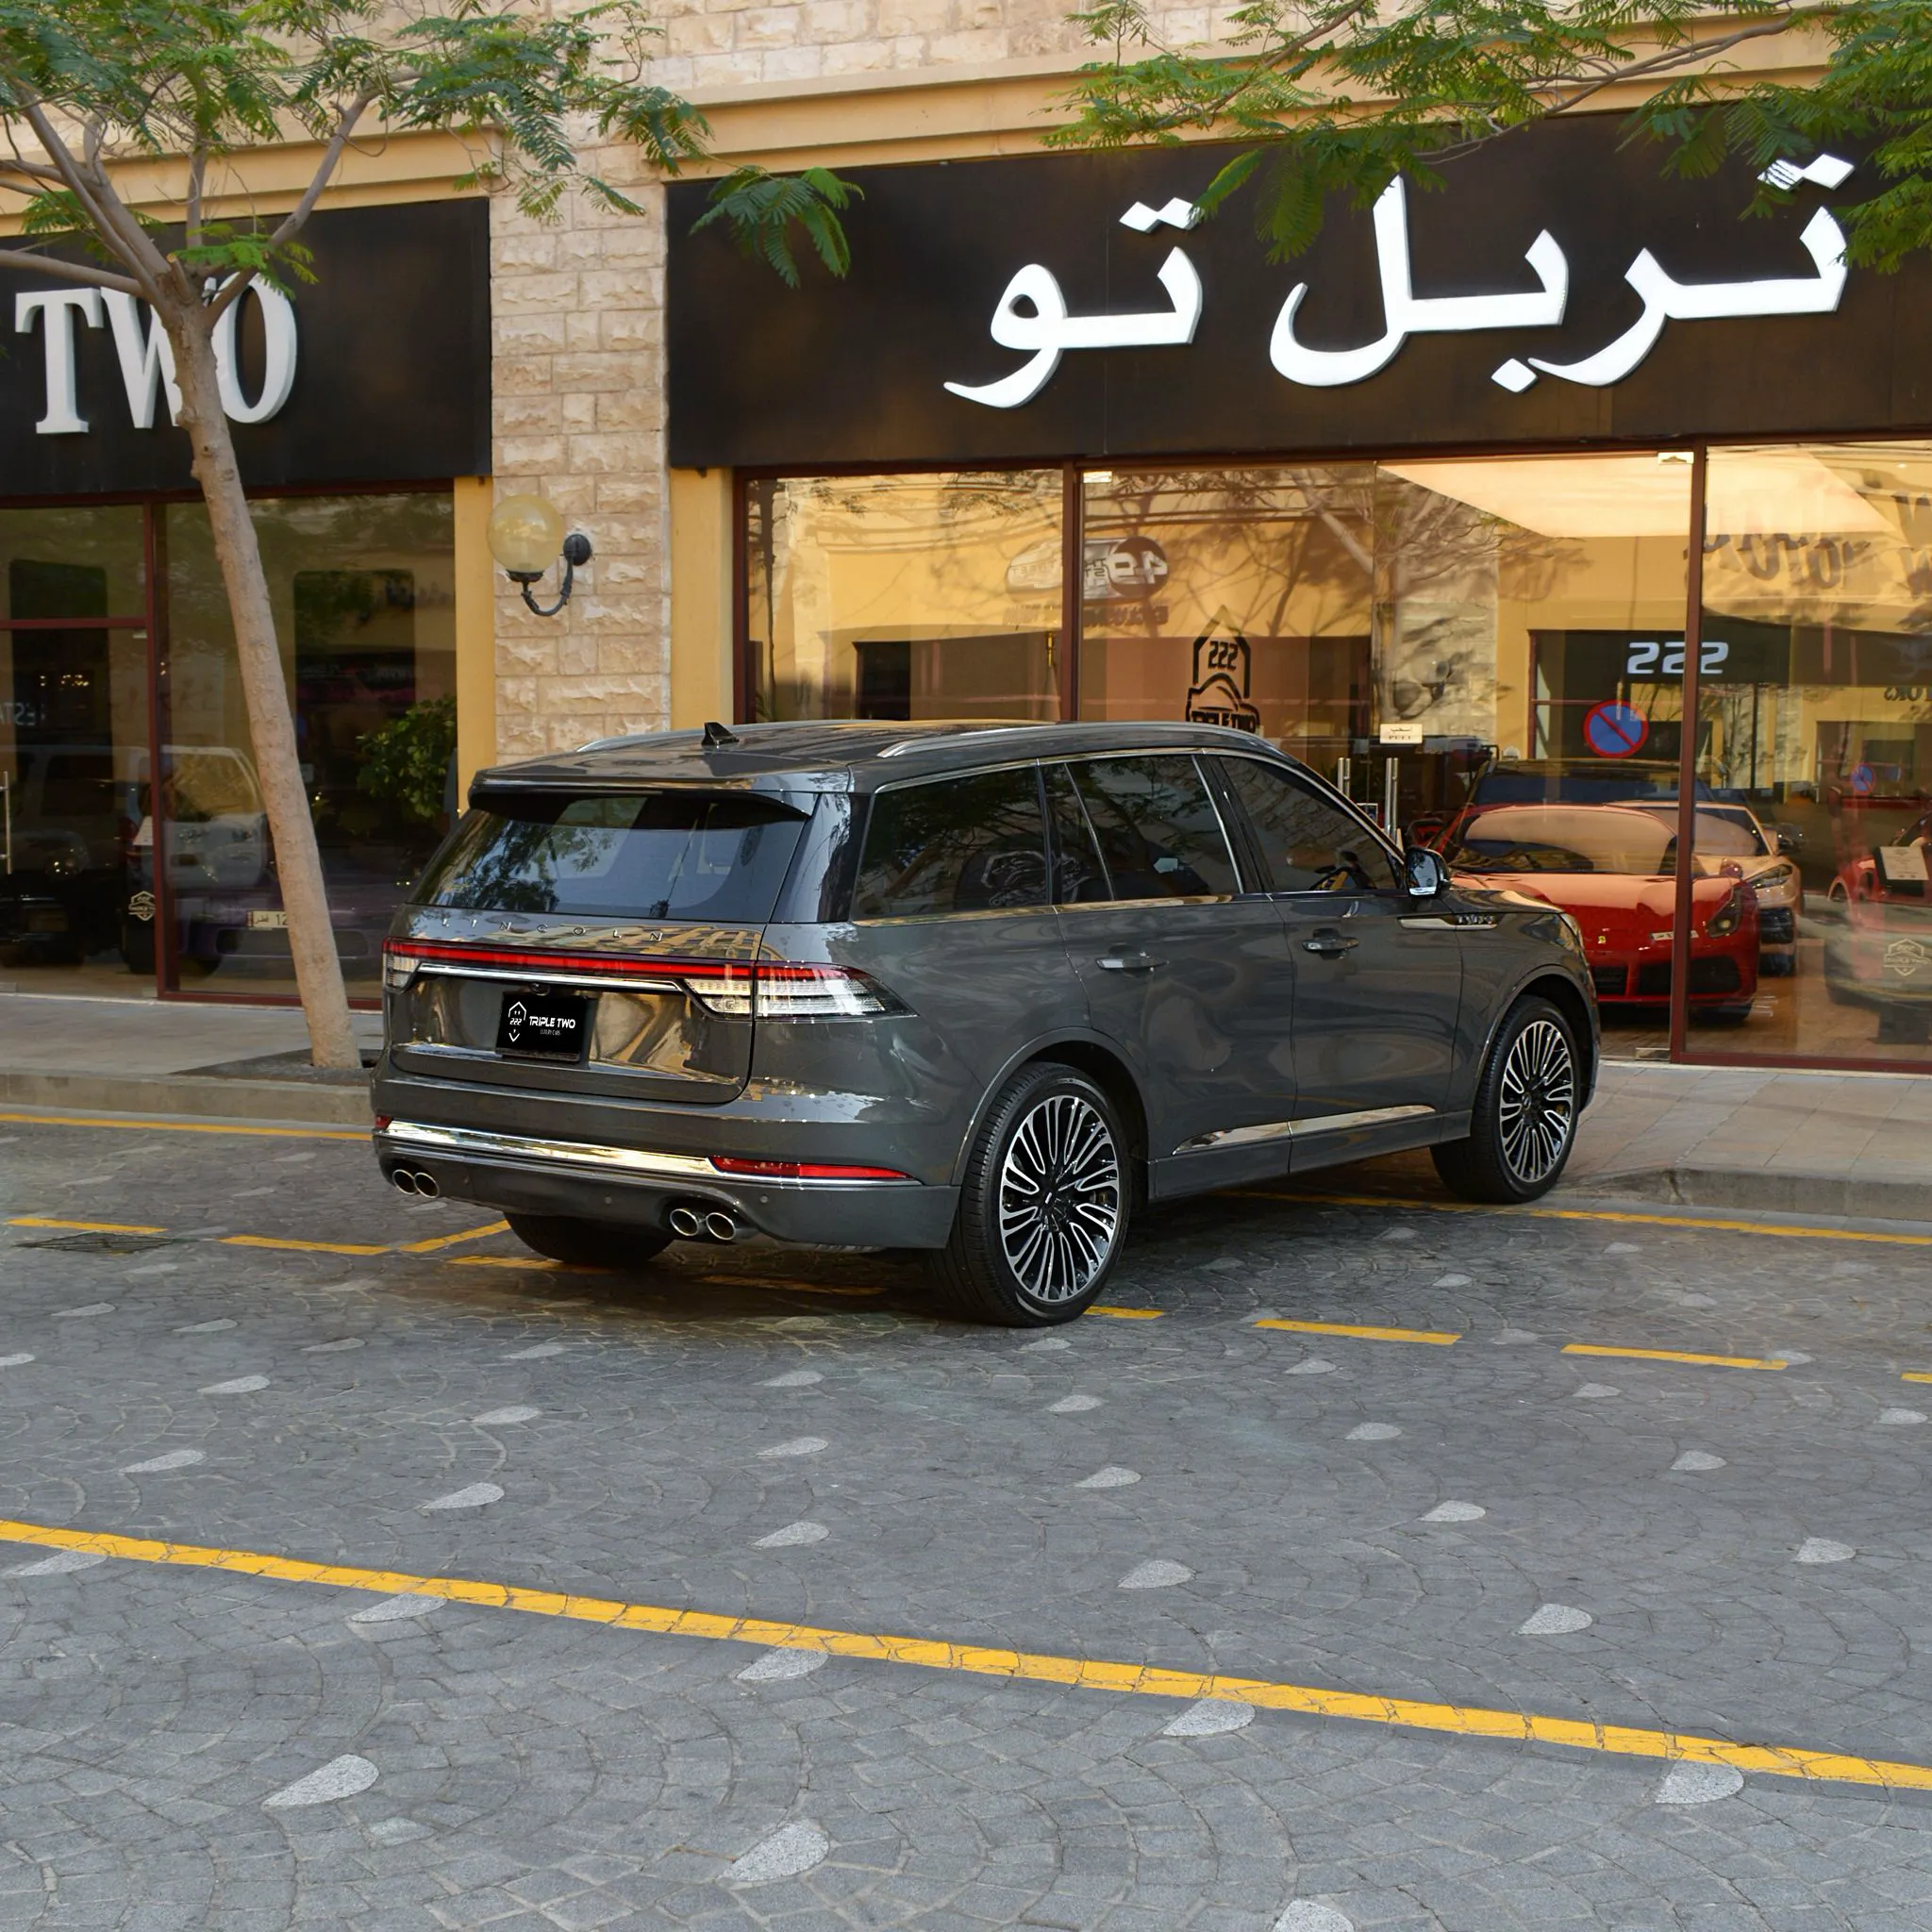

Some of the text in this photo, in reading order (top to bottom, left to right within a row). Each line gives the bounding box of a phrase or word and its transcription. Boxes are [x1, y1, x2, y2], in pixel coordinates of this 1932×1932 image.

[942, 196, 1206, 409] تو
[1208, 640, 1239, 671] 222
[1626, 641, 1729, 675] 222
[441, 917, 663, 942] LINCOLN
[509, 1017, 523, 1026] 222
[528, 1015, 576, 1029] TRIPLE TWO
